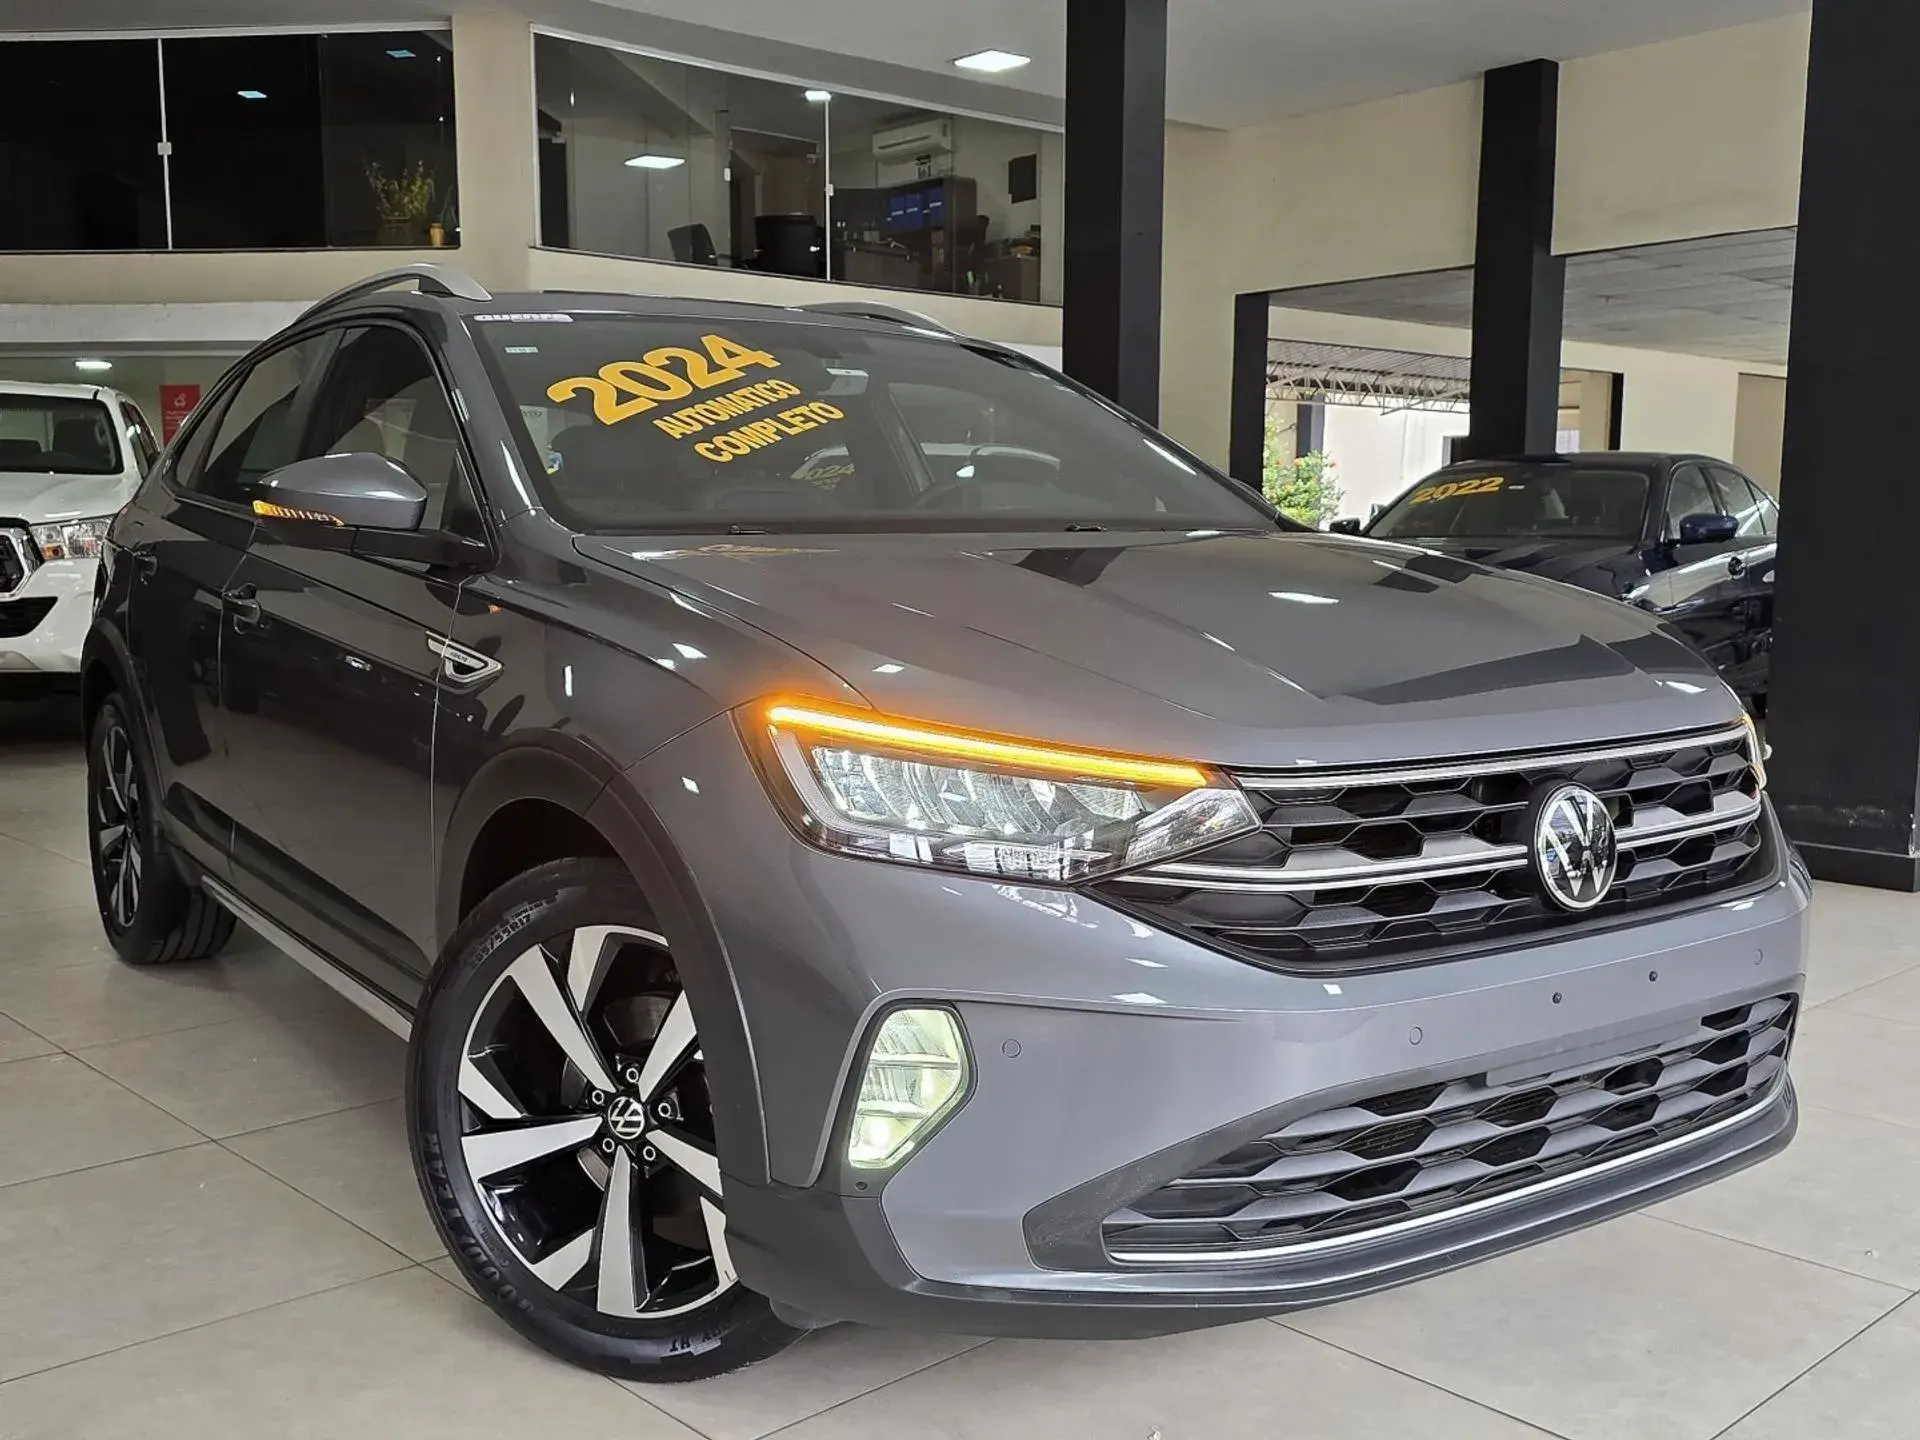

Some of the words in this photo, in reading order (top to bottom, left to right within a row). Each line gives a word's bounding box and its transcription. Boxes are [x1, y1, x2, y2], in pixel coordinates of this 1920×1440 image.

[547, 334, 781, 426] 2024
[652, 379, 801, 440] AUTOMATICO
[694, 401, 845, 463] COMPLETO
[1407, 476, 1504, 505] 2022
